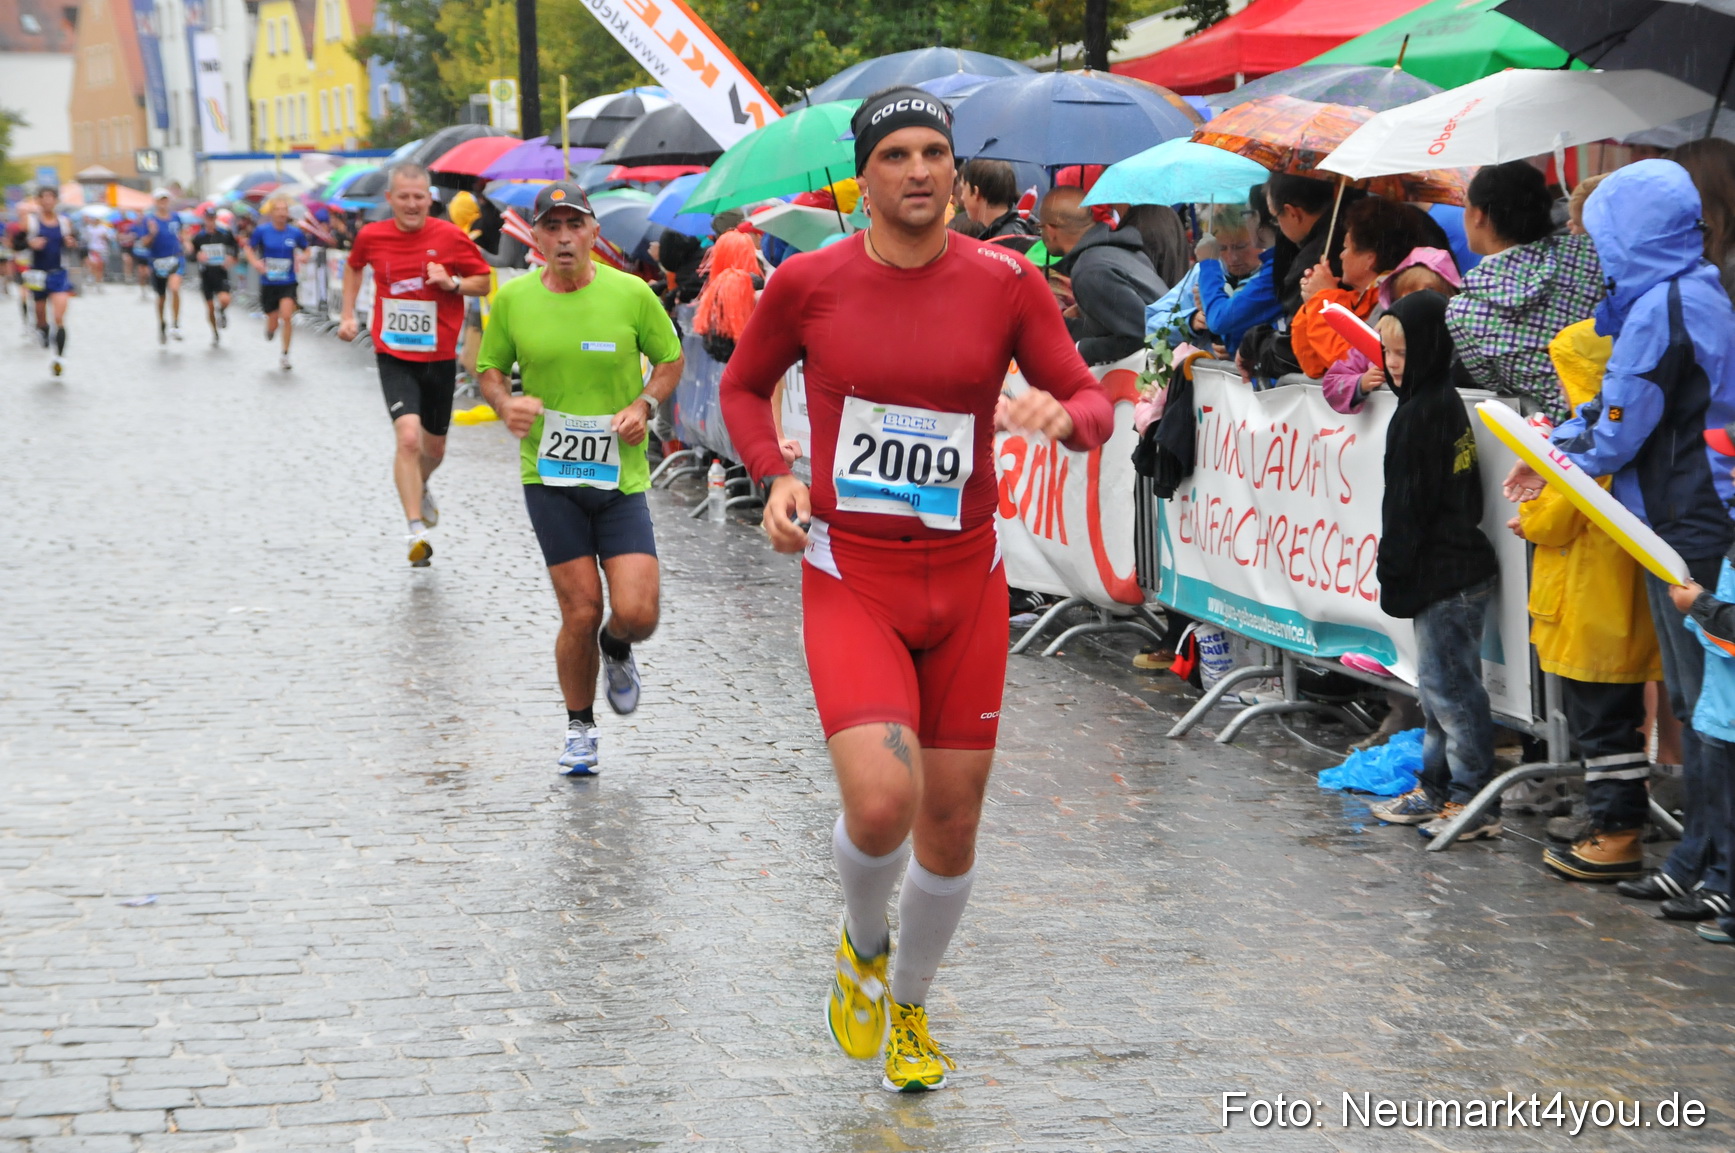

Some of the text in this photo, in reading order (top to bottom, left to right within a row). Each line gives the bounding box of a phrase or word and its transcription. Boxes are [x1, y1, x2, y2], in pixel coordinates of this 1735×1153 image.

[388, 312, 431, 333] 2036
[883, 413, 937, 431] BOCK
[545, 431, 612, 463] 2207
[848, 432, 960, 486] 2009
[558, 463, 596, 478] Jürgen
